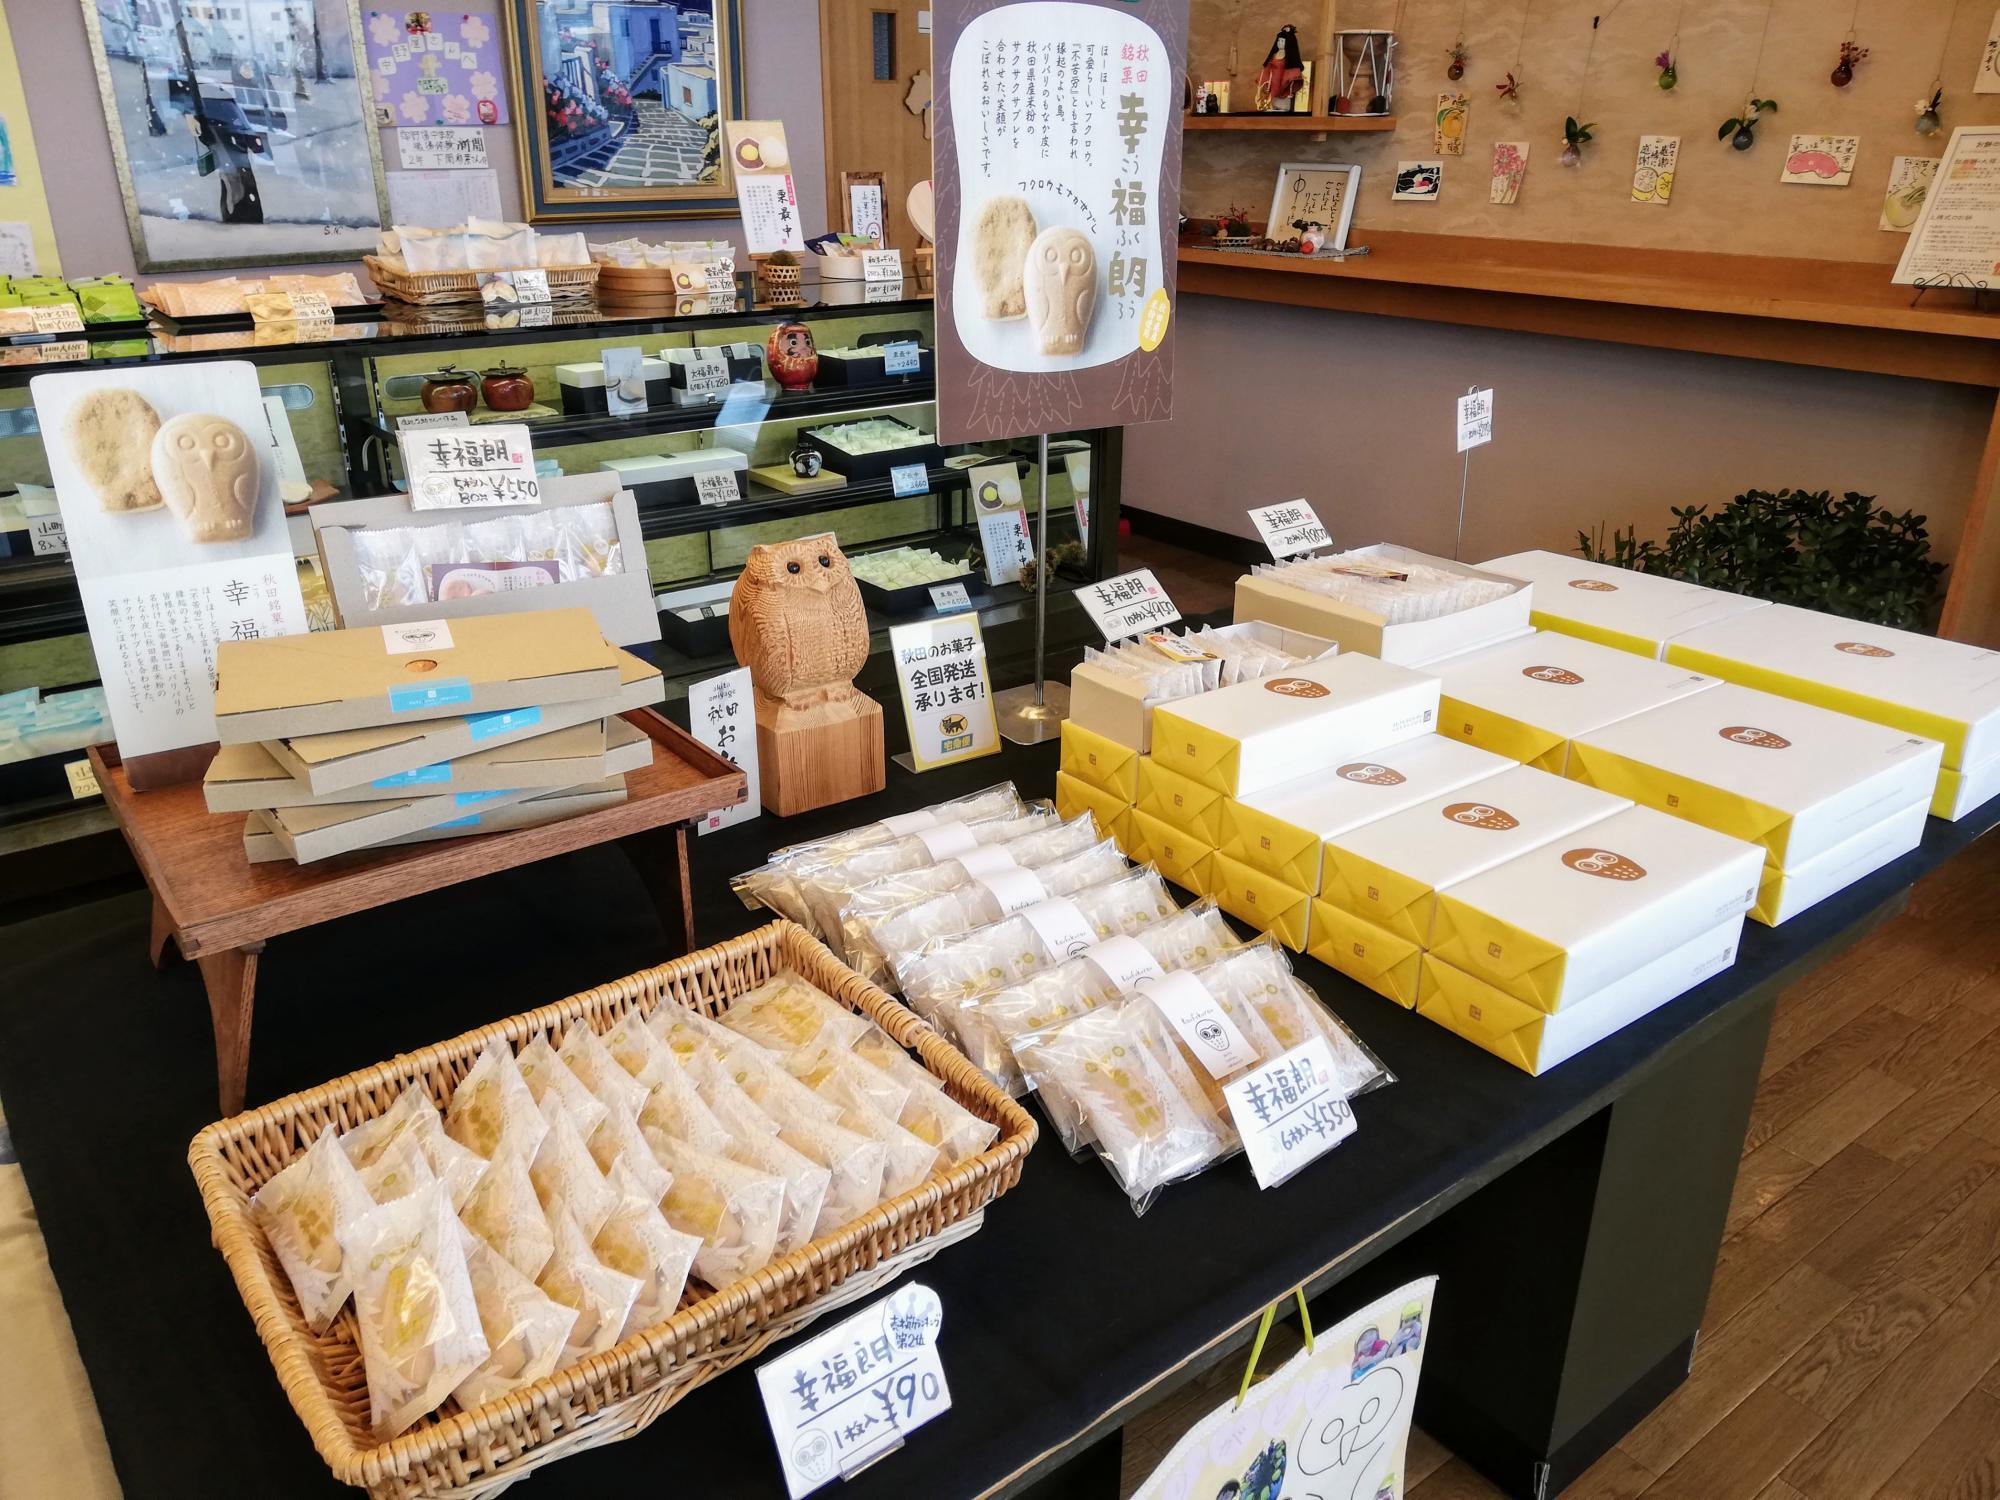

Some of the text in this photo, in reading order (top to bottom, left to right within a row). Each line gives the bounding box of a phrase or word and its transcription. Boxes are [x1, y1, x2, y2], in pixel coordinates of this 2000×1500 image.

[1121, 43, 1134, 84] 銘菓
[1136, 44, 1149, 83] 秋田
[1026, 41, 1037, 135] 秋田県産米粉の
[427, 437, 511, 469] 幸福朗
[488, 474, 539, 503] ¥550
[1260, 507, 1305, 529] 幸福朗
[263, 572, 286, 625] 秋田銘菓
[1094, 577, 1148, 607] 幸福朗
[901, 636, 976, 665] 秋田のお菓子
[911, 658, 977, 691] 全国発送
[914, 681, 985, 712] 承ります!
[943, 735, 971, 751] 宅急便
[1242, 1057, 1318, 1123] 幸福朗
[1280, 1098, 1351, 1151] 6枚入 ¥550
[871, 1371, 941, 1430] ¥90
